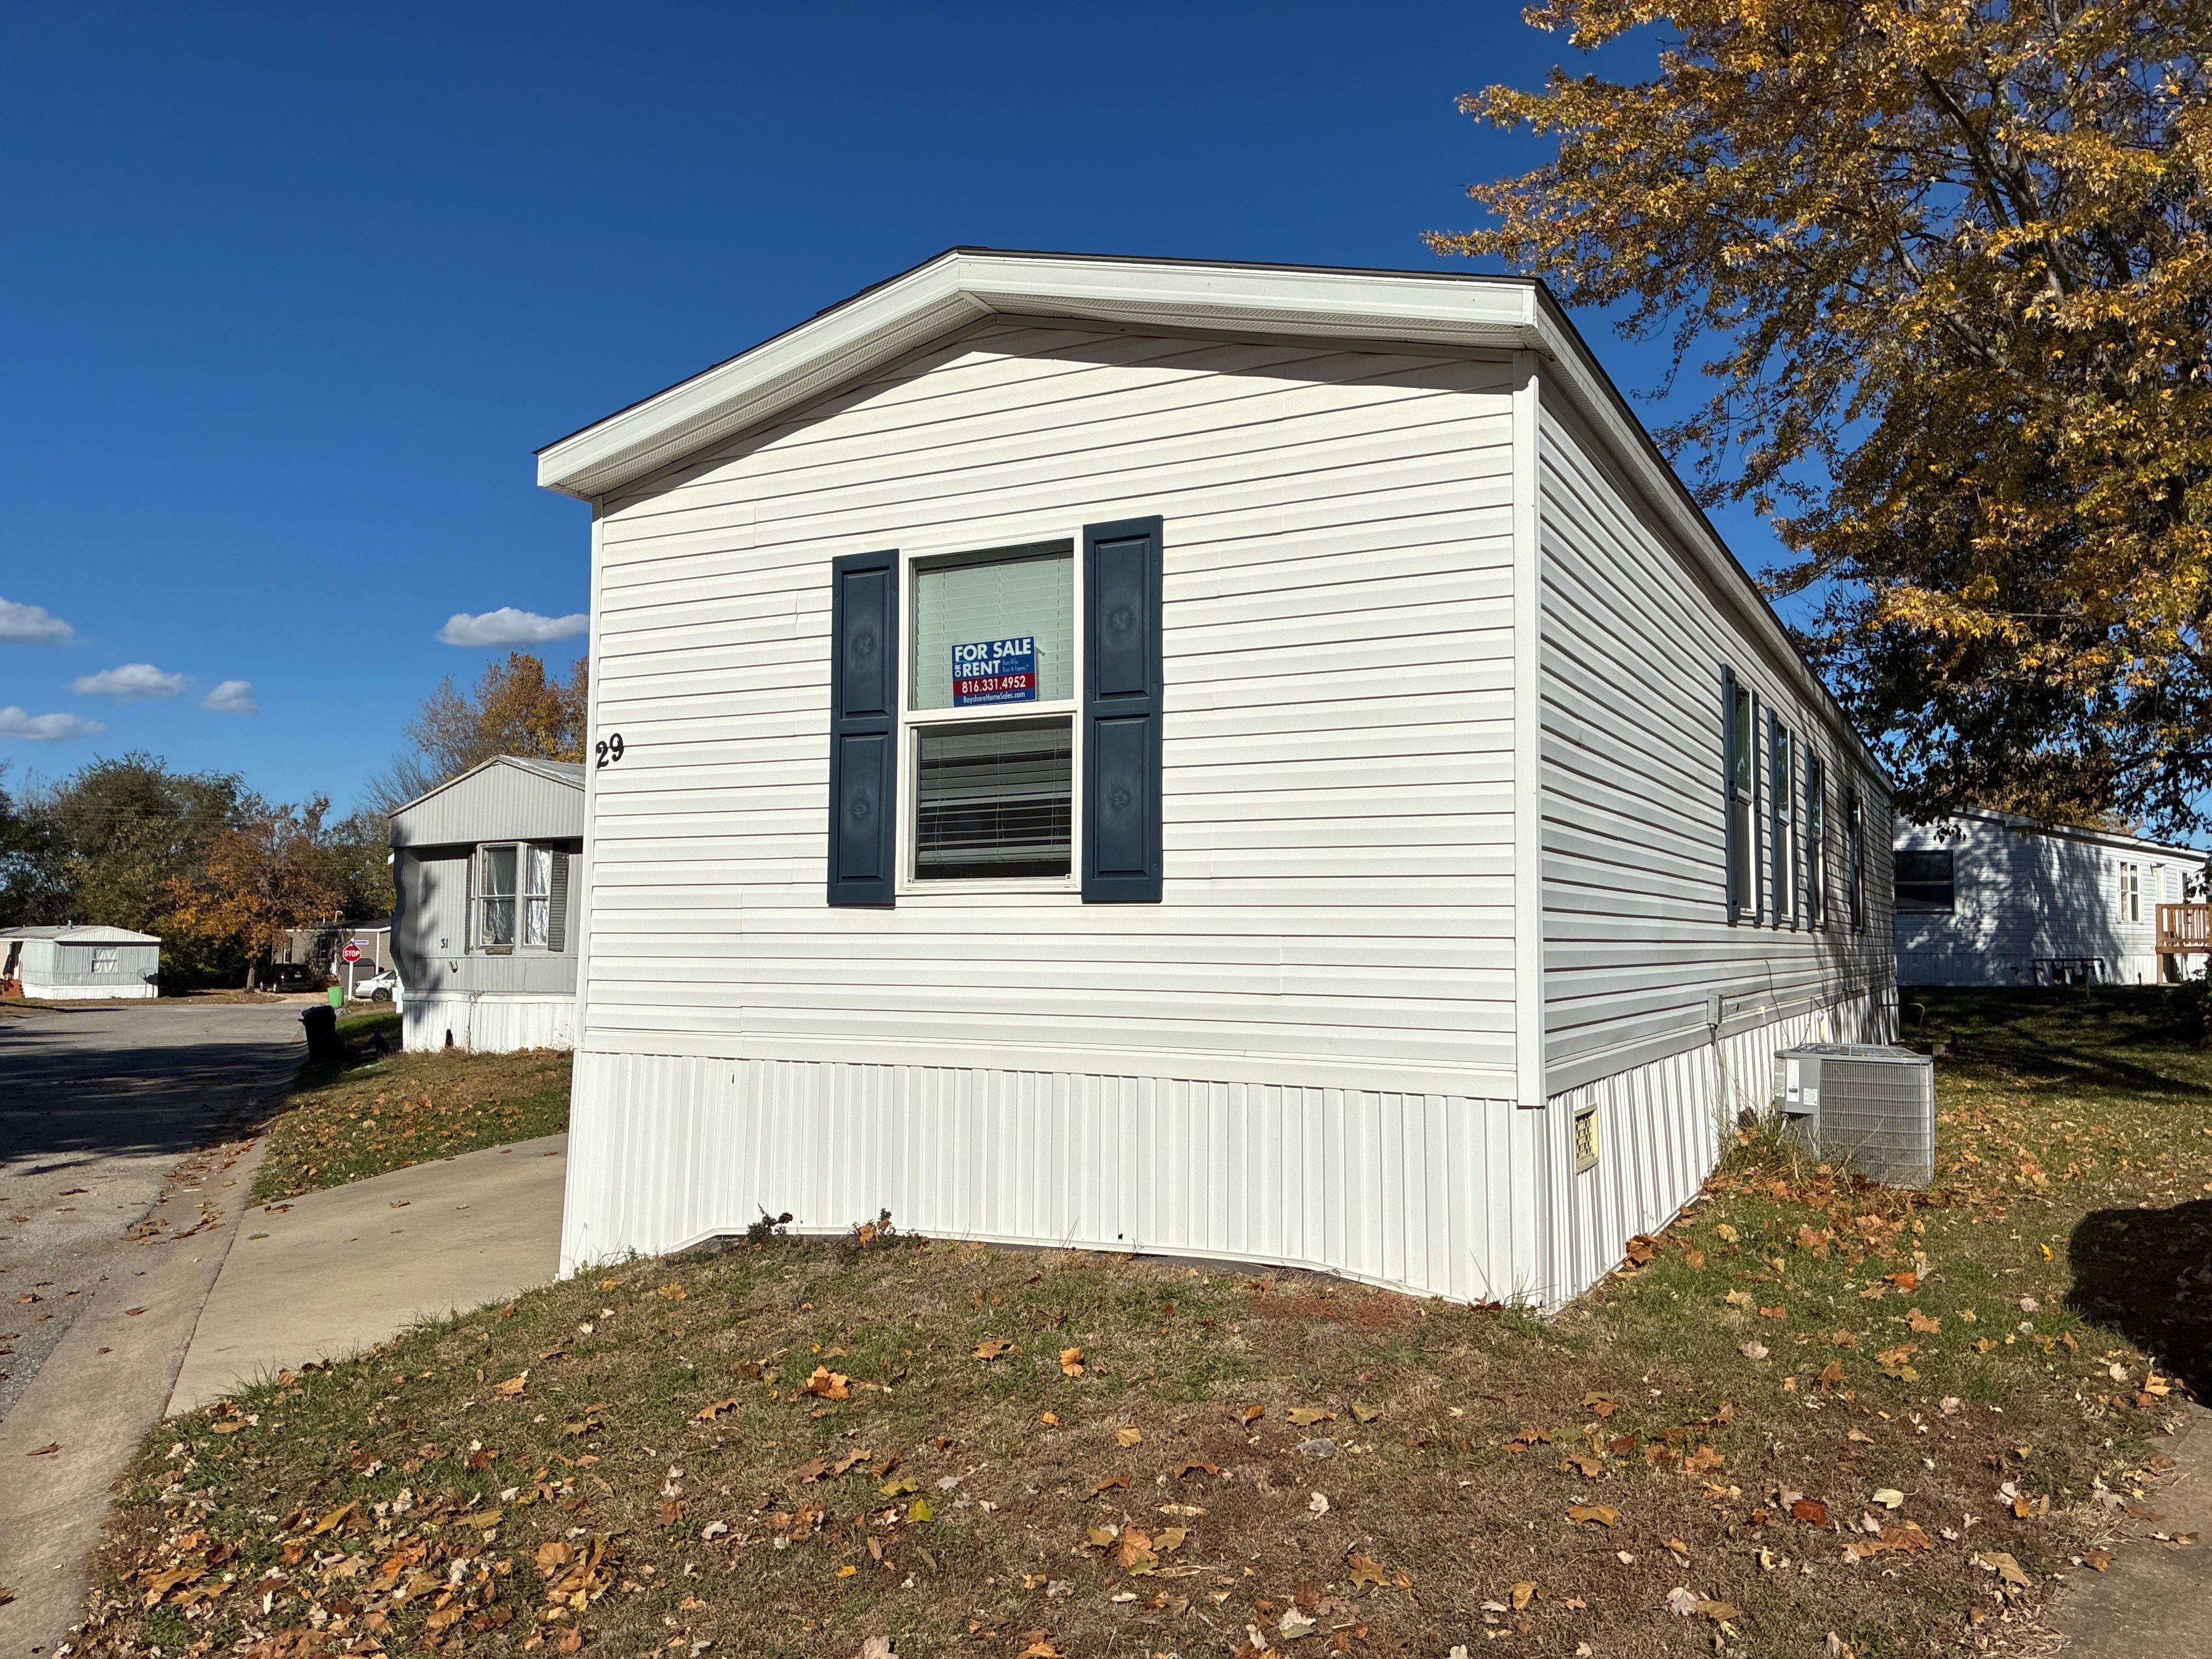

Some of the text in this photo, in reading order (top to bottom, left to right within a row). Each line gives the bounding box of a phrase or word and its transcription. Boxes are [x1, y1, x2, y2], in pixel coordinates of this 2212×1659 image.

[955, 639, 1031, 662] FOR SALE
[955, 663, 961, 678] OR
[963, 659, 1001, 678] RENT
[962, 675, 1026, 693] 816.331.4952
[963, 691, 1025, 704] BayshoreHomeSales.com
[596, 733, 624, 769] 29
[441, 938, 448, 949] 31
